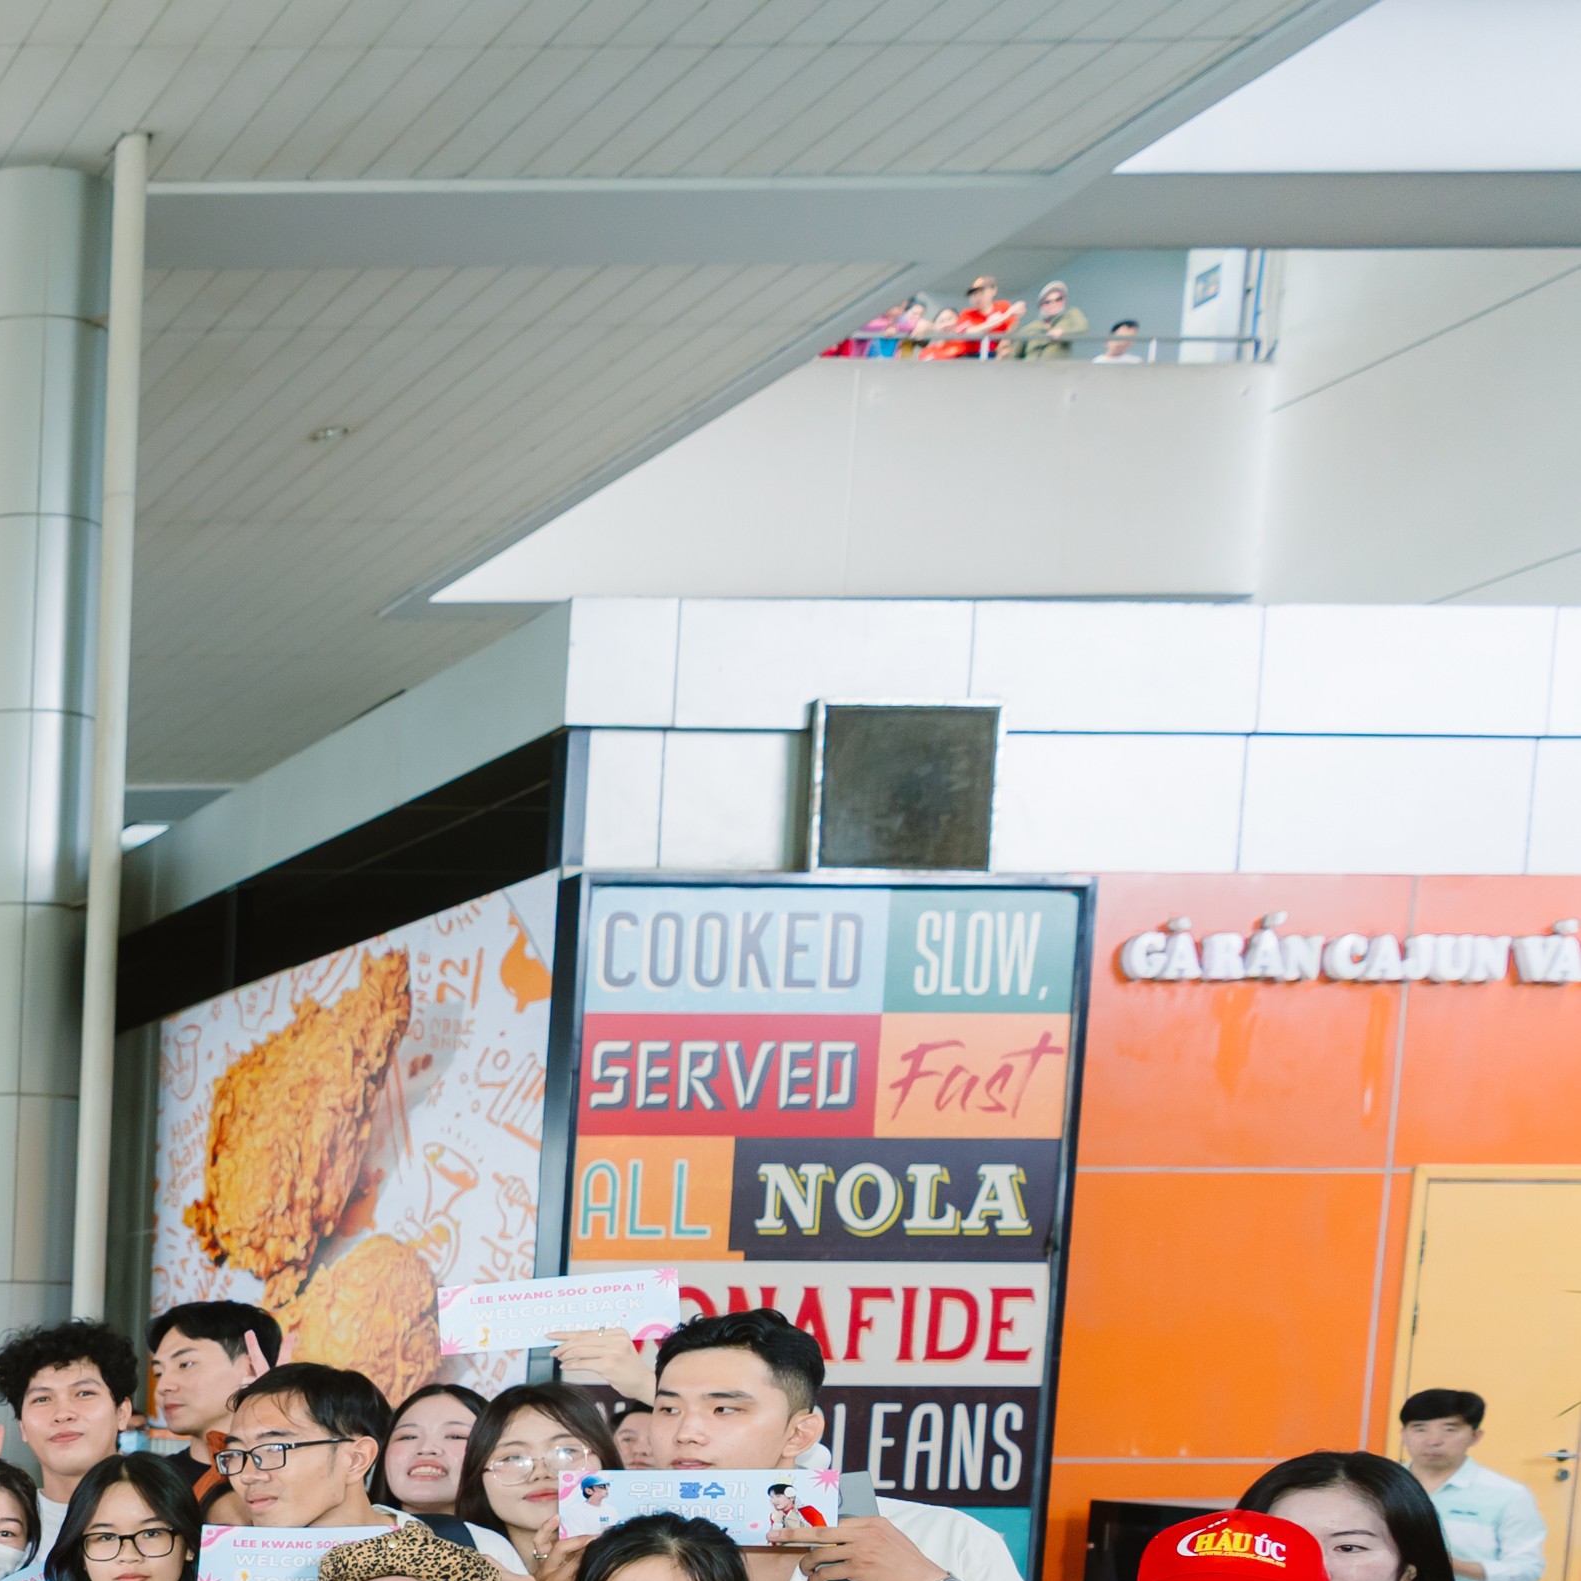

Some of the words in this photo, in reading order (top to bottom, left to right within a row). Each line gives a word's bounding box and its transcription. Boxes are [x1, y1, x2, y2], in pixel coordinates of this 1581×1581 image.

[597, 909, 866, 993] COOKED
[914, 909, 1048, 1000] SLOW,
[1324, 933, 1511, 983] CAJUN
[588, 1039, 860, 1112] SERVED
[889, 1031, 1064, 1122] Fast
[578, 1160, 710, 1241] ALL
[756, 1162, 1032, 1238] NOLA
[470, 1294, 494, 1306] LEE
[498, 1290, 554, 1304] KWANG
[558, 1286, 588, 1298] SOO
[592, 1283, 634, 1296] OPPA
[474, 1300, 581, 1323] WELCOME
[585, 1296, 644, 1313] BACK
[495, 1326, 523, 1341] TO
[629, 1481, 674, 1499] 우리
[679, 1480, 749, 1500] 광수가
[233, 1539, 257, 1548] LEE
[262, 1539, 313, 1549] KWANG
[1254, 1533, 1286, 1562] ÚC
[236, 1553, 319, 1568] WELCOM
